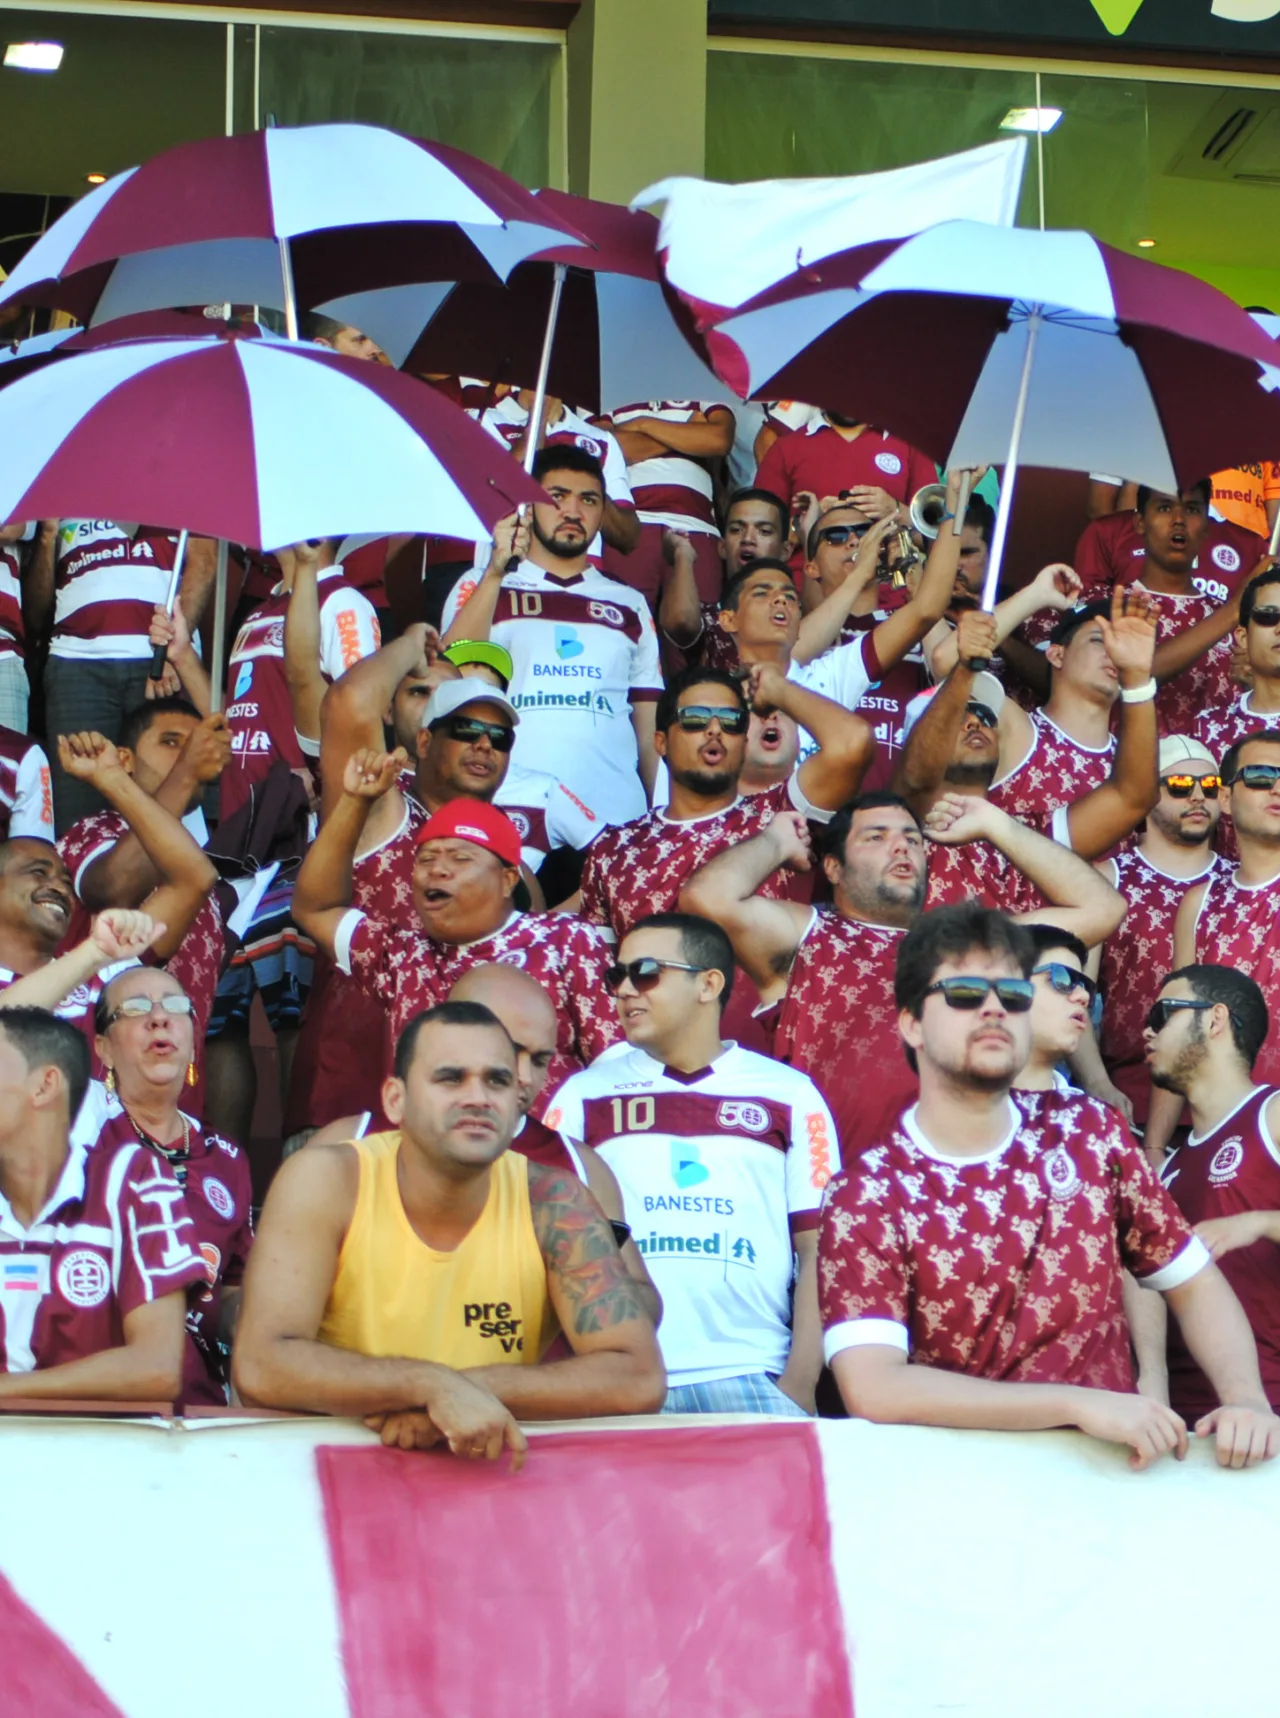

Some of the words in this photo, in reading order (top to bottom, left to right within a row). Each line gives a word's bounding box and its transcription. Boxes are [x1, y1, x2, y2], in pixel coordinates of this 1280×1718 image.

[509, 590, 543, 616] 10
[533, 664, 602, 680] BANESTES
[511, 690, 592, 710] Unimed
[856, 696, 900, 712] ESTES
[611, 1096, 655, 1134] 10
[806, 1112, 833, 1189] BMG
[644, 1195, 735, 1215] BANESTES
[464, 1302, 513, 1327] pre
[479, 1320, 523, 1338] ser
